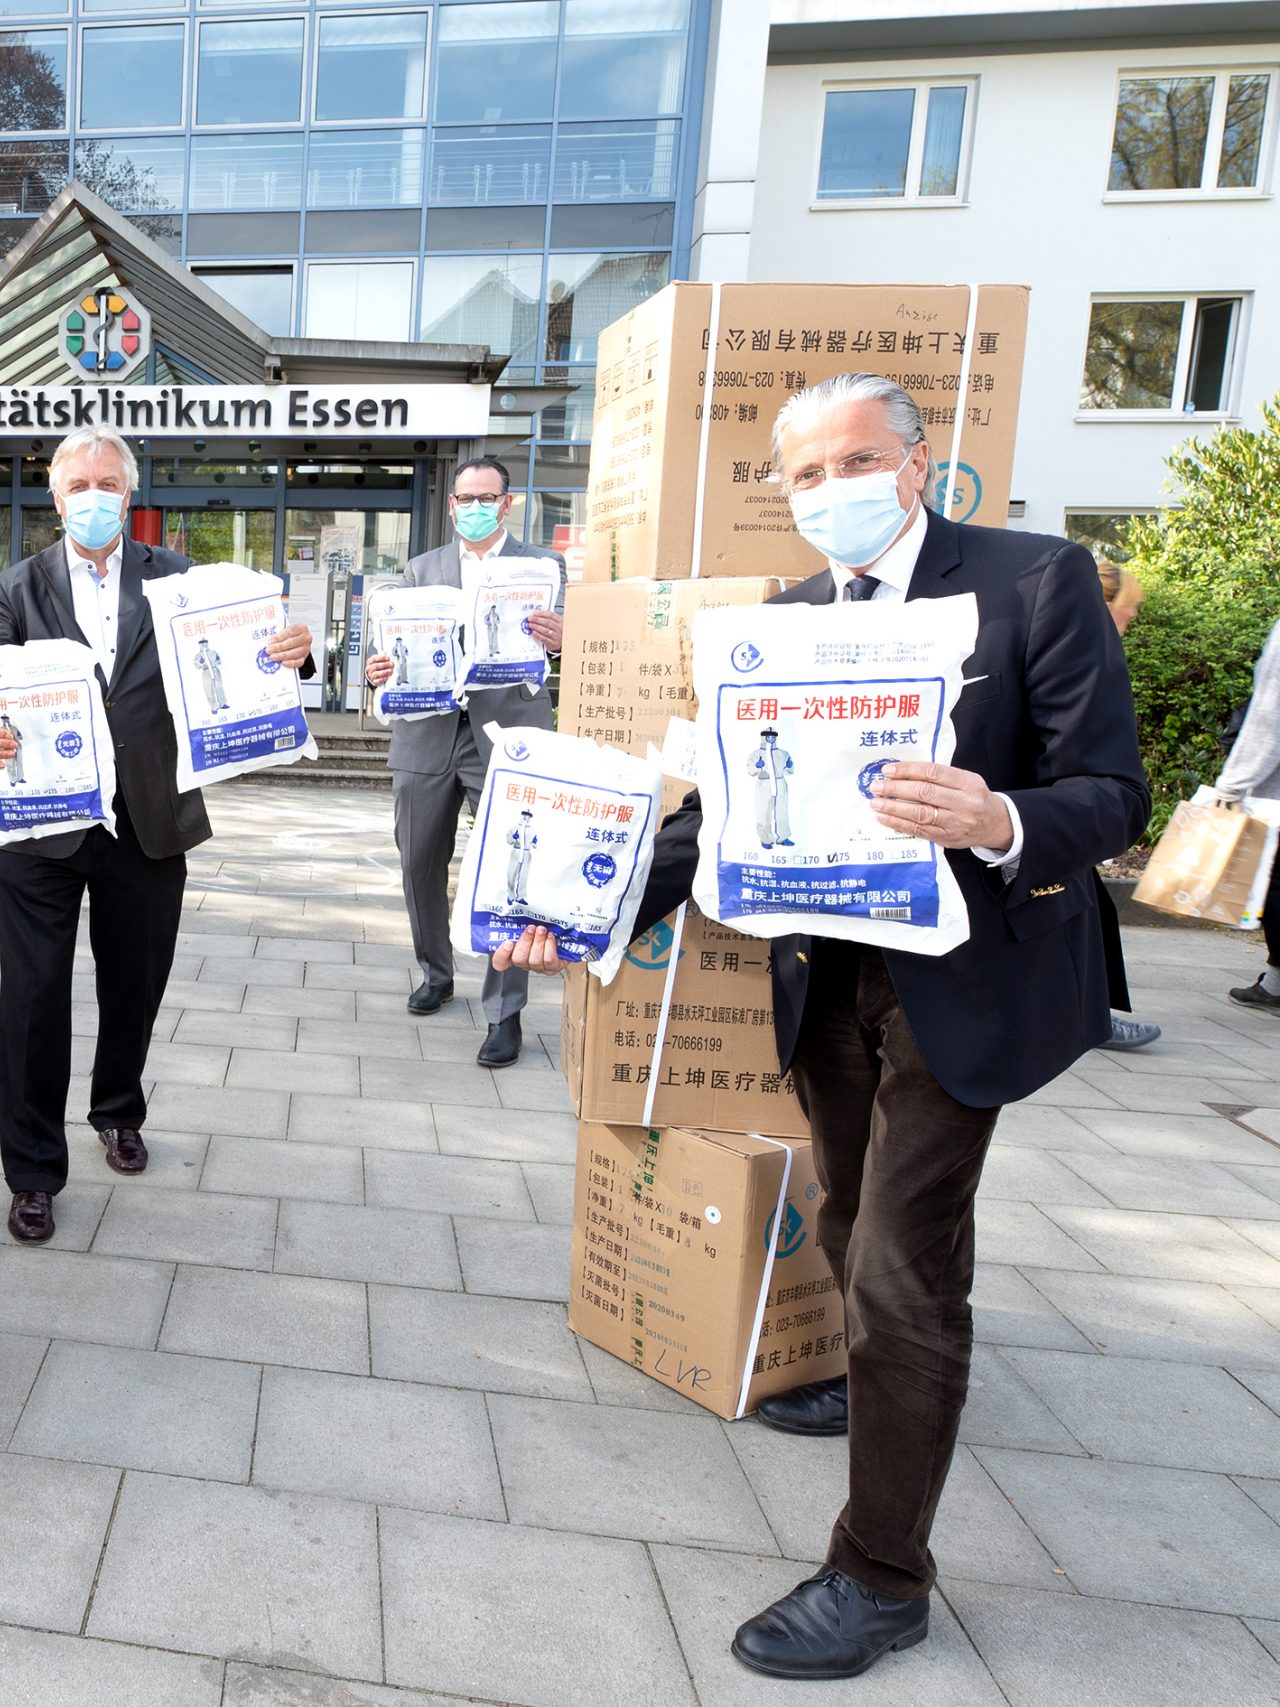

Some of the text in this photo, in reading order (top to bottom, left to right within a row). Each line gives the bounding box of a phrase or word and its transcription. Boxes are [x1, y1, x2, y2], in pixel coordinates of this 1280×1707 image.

[288, 390, 409, 428] Essen
[639, 687, 650, 699] kg
[736, 694, 921, 721] 医用一次性防护服
[859, 728, 919, 747] 连体式
[506, 783, 635, 824] 医用一次性防护服
[586, 826, 629, 844] 连体式
[770, 855, 787, 865] 165
[802, 855, 820, 866] 170
[866, 850, 884, 862] 180
[900, 849, 918, 859] 185
[740, 888, 912, 904] 重庆上坤医疗器械有限公司
[633, 1213, 644, 1227] kg
[704, 1243, 716, 1259] kg
